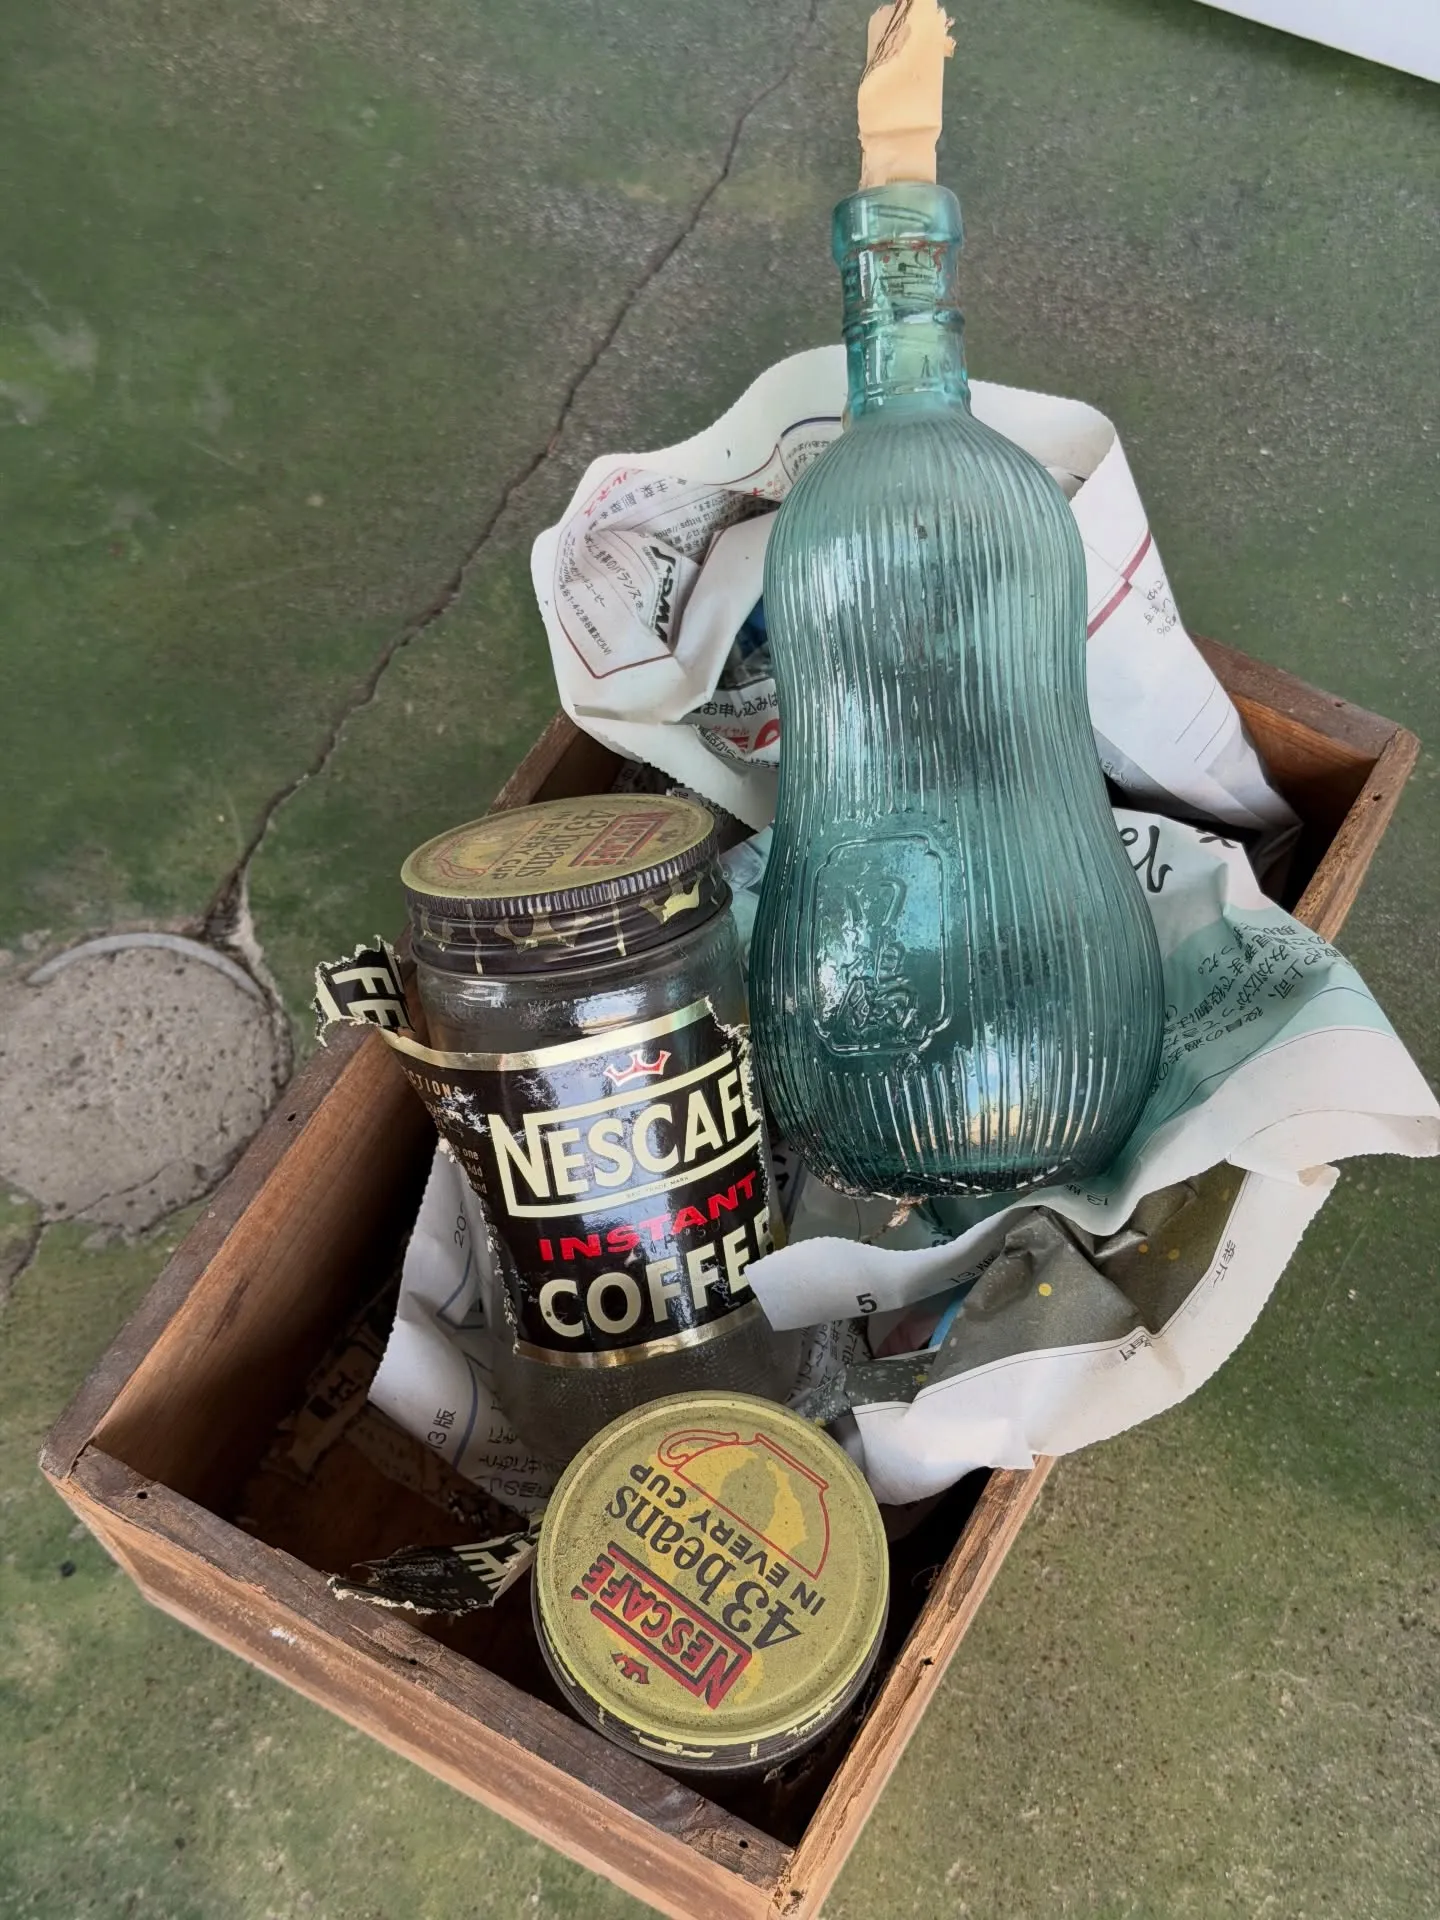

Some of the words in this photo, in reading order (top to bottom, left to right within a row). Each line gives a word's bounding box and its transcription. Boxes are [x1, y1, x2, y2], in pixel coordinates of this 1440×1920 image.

[564, 809, 618, 832] 43
[492, 858, 523, 880] CUP
[515, 832, 594, 879] beans
[538, 1172, 757, 1261] INSTANT
[857, 1292, 879, 1315] 5
[629, 1464, 687, 1509] CUP
[604, 1485, 737, 1606] beans
[688, 1508, 791, 1589] EVERY
[721, 1580, 802, 1650] 43
[789, 1581, 826, 1616] IN
[570, 1541, 753, 1710] NESCAFÉ
